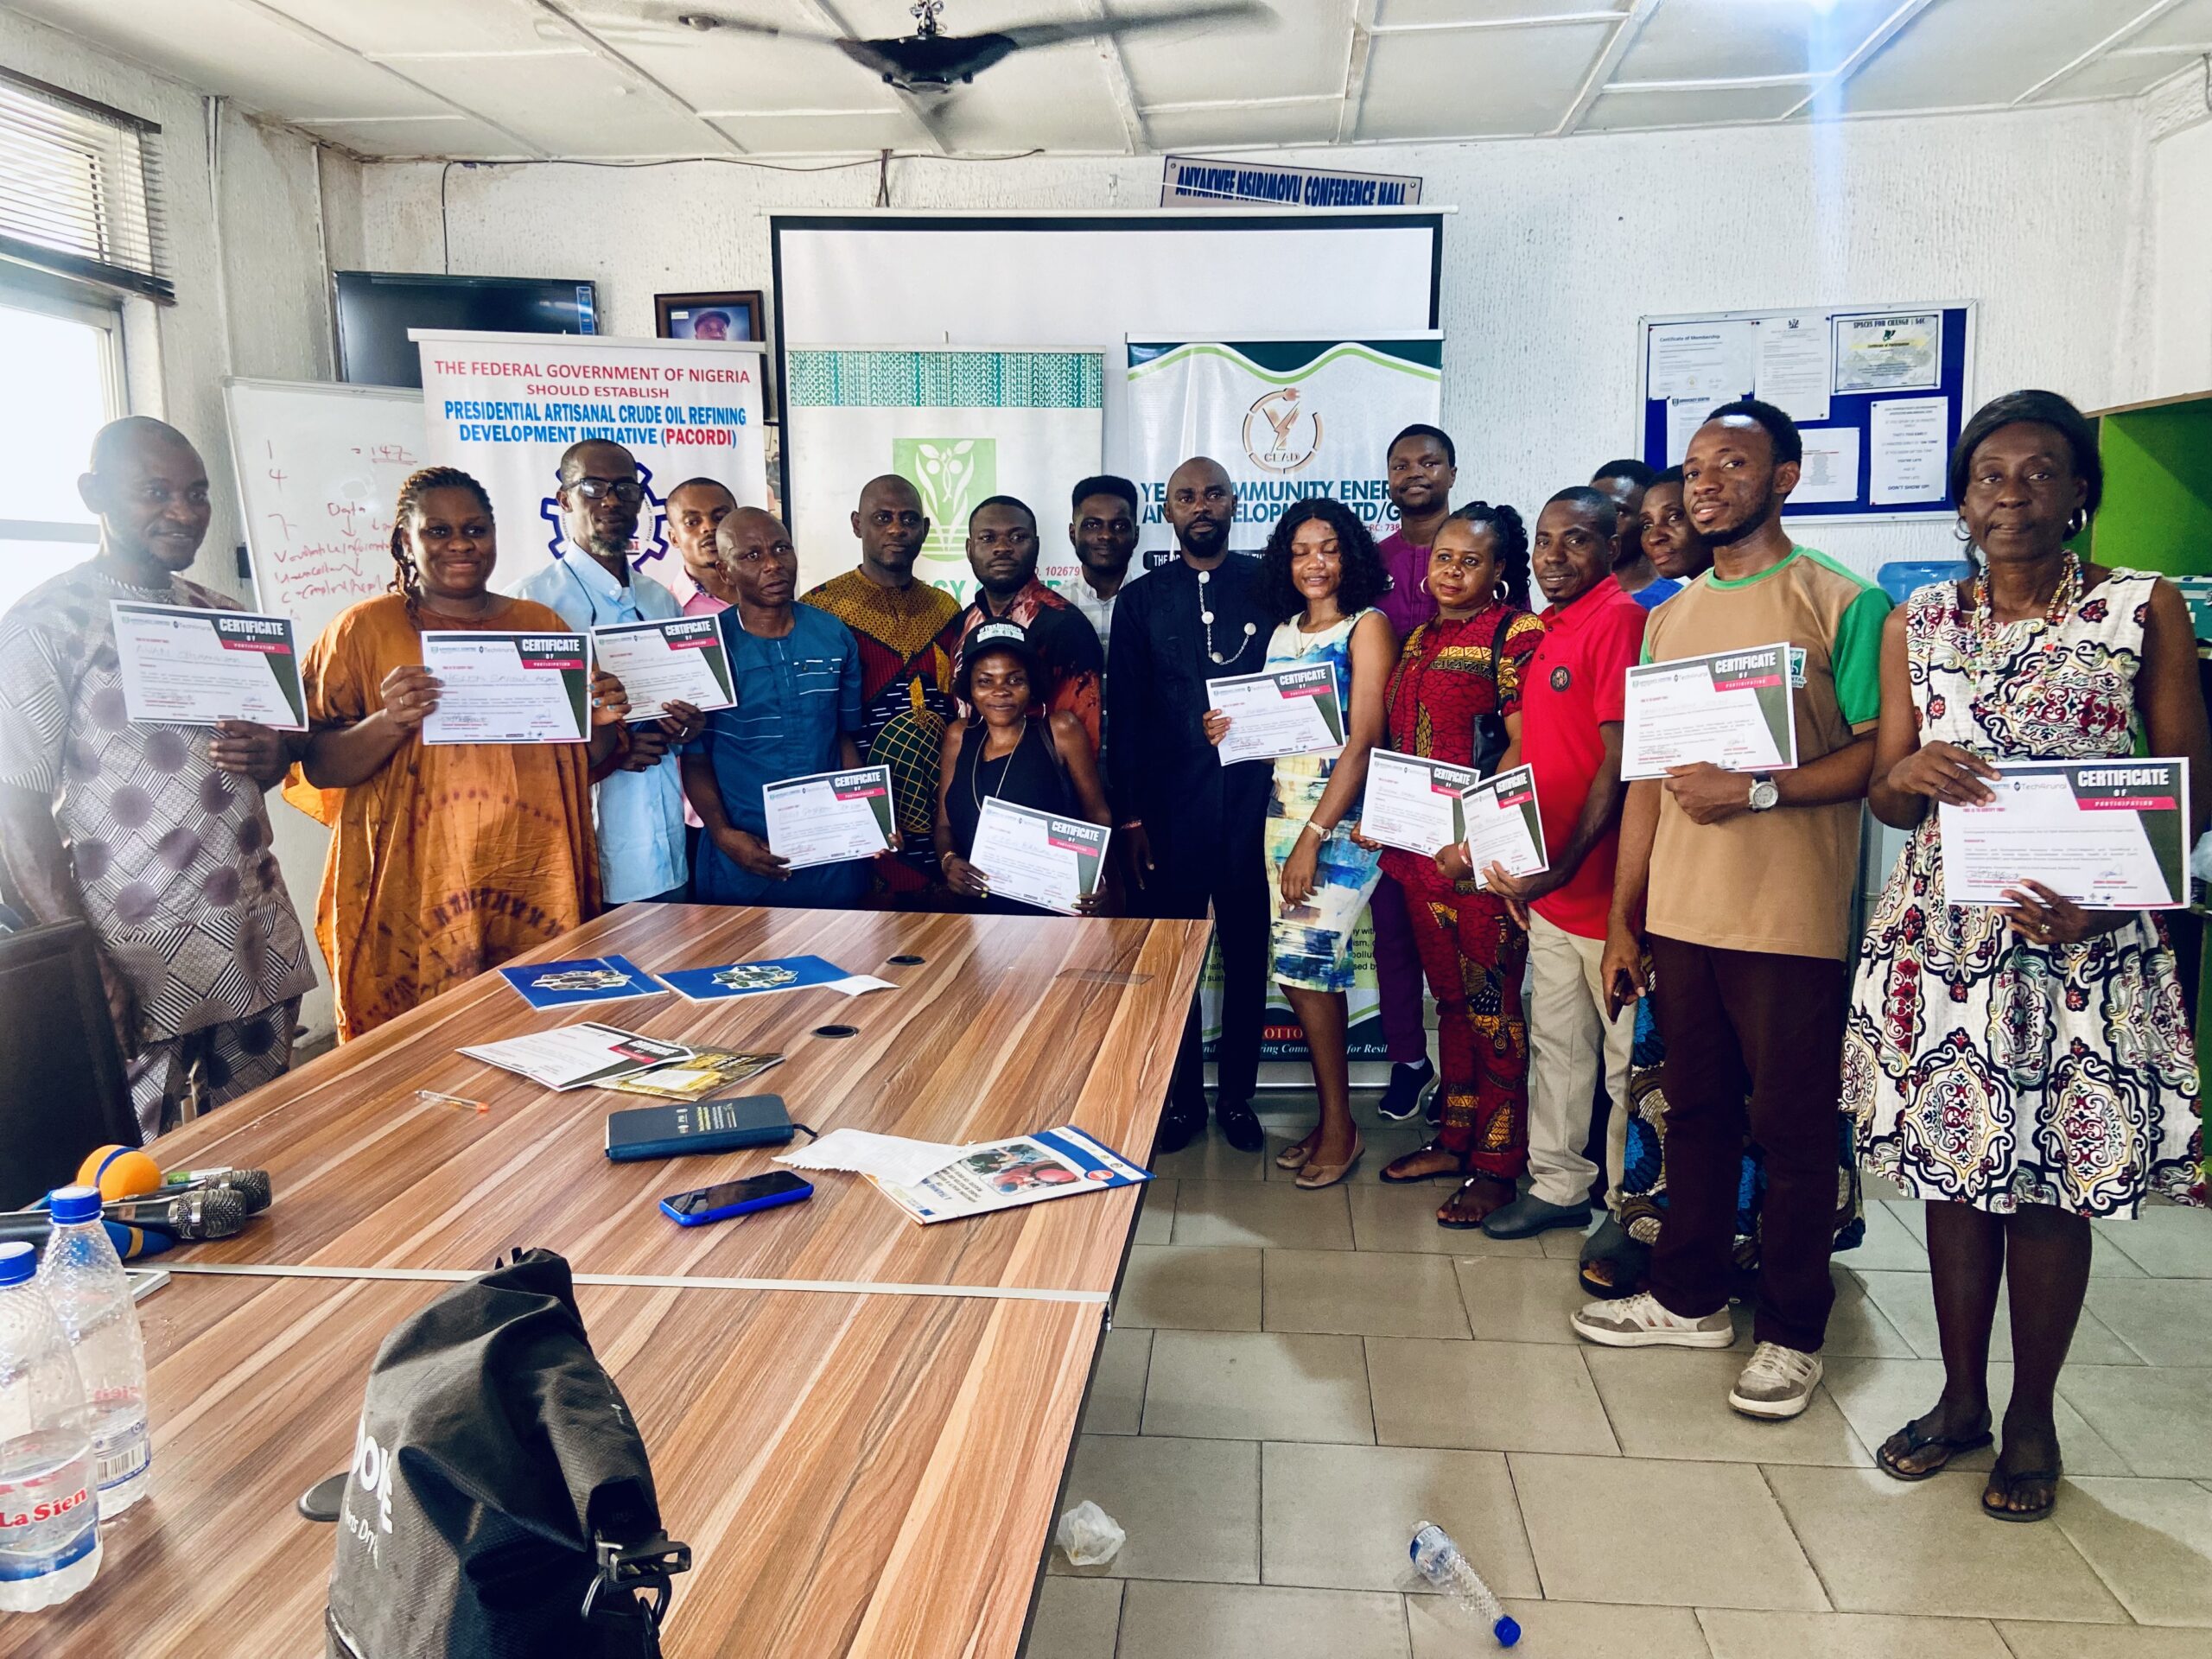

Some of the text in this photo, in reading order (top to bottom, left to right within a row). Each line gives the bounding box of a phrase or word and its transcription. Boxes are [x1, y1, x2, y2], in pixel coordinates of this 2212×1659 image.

[1304, 176, 1376, 207] CONFERENCE
[1377, 181, 1406, 205] HALL
[434, 360, 750, 384] THE FEDERAL GOVERNMENT OF NIGERIA
[527, 385, 670, 399] SHOULD ESTABLISH
[445, 402, 747, 426] PRESIDENTIAL ARTISANAL CRUDE OIL REFINING
[460, 426, 737, 448] DEVELOPMENT INITIATIVE (PACORDI)
[1141, 480, 1392, 502] YE MMUNITY ENER
[1233, 502, 1288, 523] ELOP
[1046, 567, 1080, 576] 102679
[219, 618, 284, 636] CERTIFICATE
[664, 620, 711, 637] CERTIFICATE
[522, 639, 580, 652] CERTIFICATE
[1715, 652, 1777, 674] CERTIFICATE
[1279, 669, 1326, 686] CERTIFICATE
[835, 771, 880, 788] CERTIFICATE
[1433, 766, 1471, 786] CERTIFICATE
[1496, 772, 1528, 794] CERTIFICATE
[2077, 768, 2170, 787] CERTIFICATE
[1051, 821, 1100, 842] CERTIFICATE
[1264, 1027, 1303, 1039] OTTO
[1260, 1044, 1279, 1054] ring
[1347, 1044, 1362, 1054] for
[1363, 1044, 1389, 1053] Resil
[0, 1487, 87, 1528] La Sien
